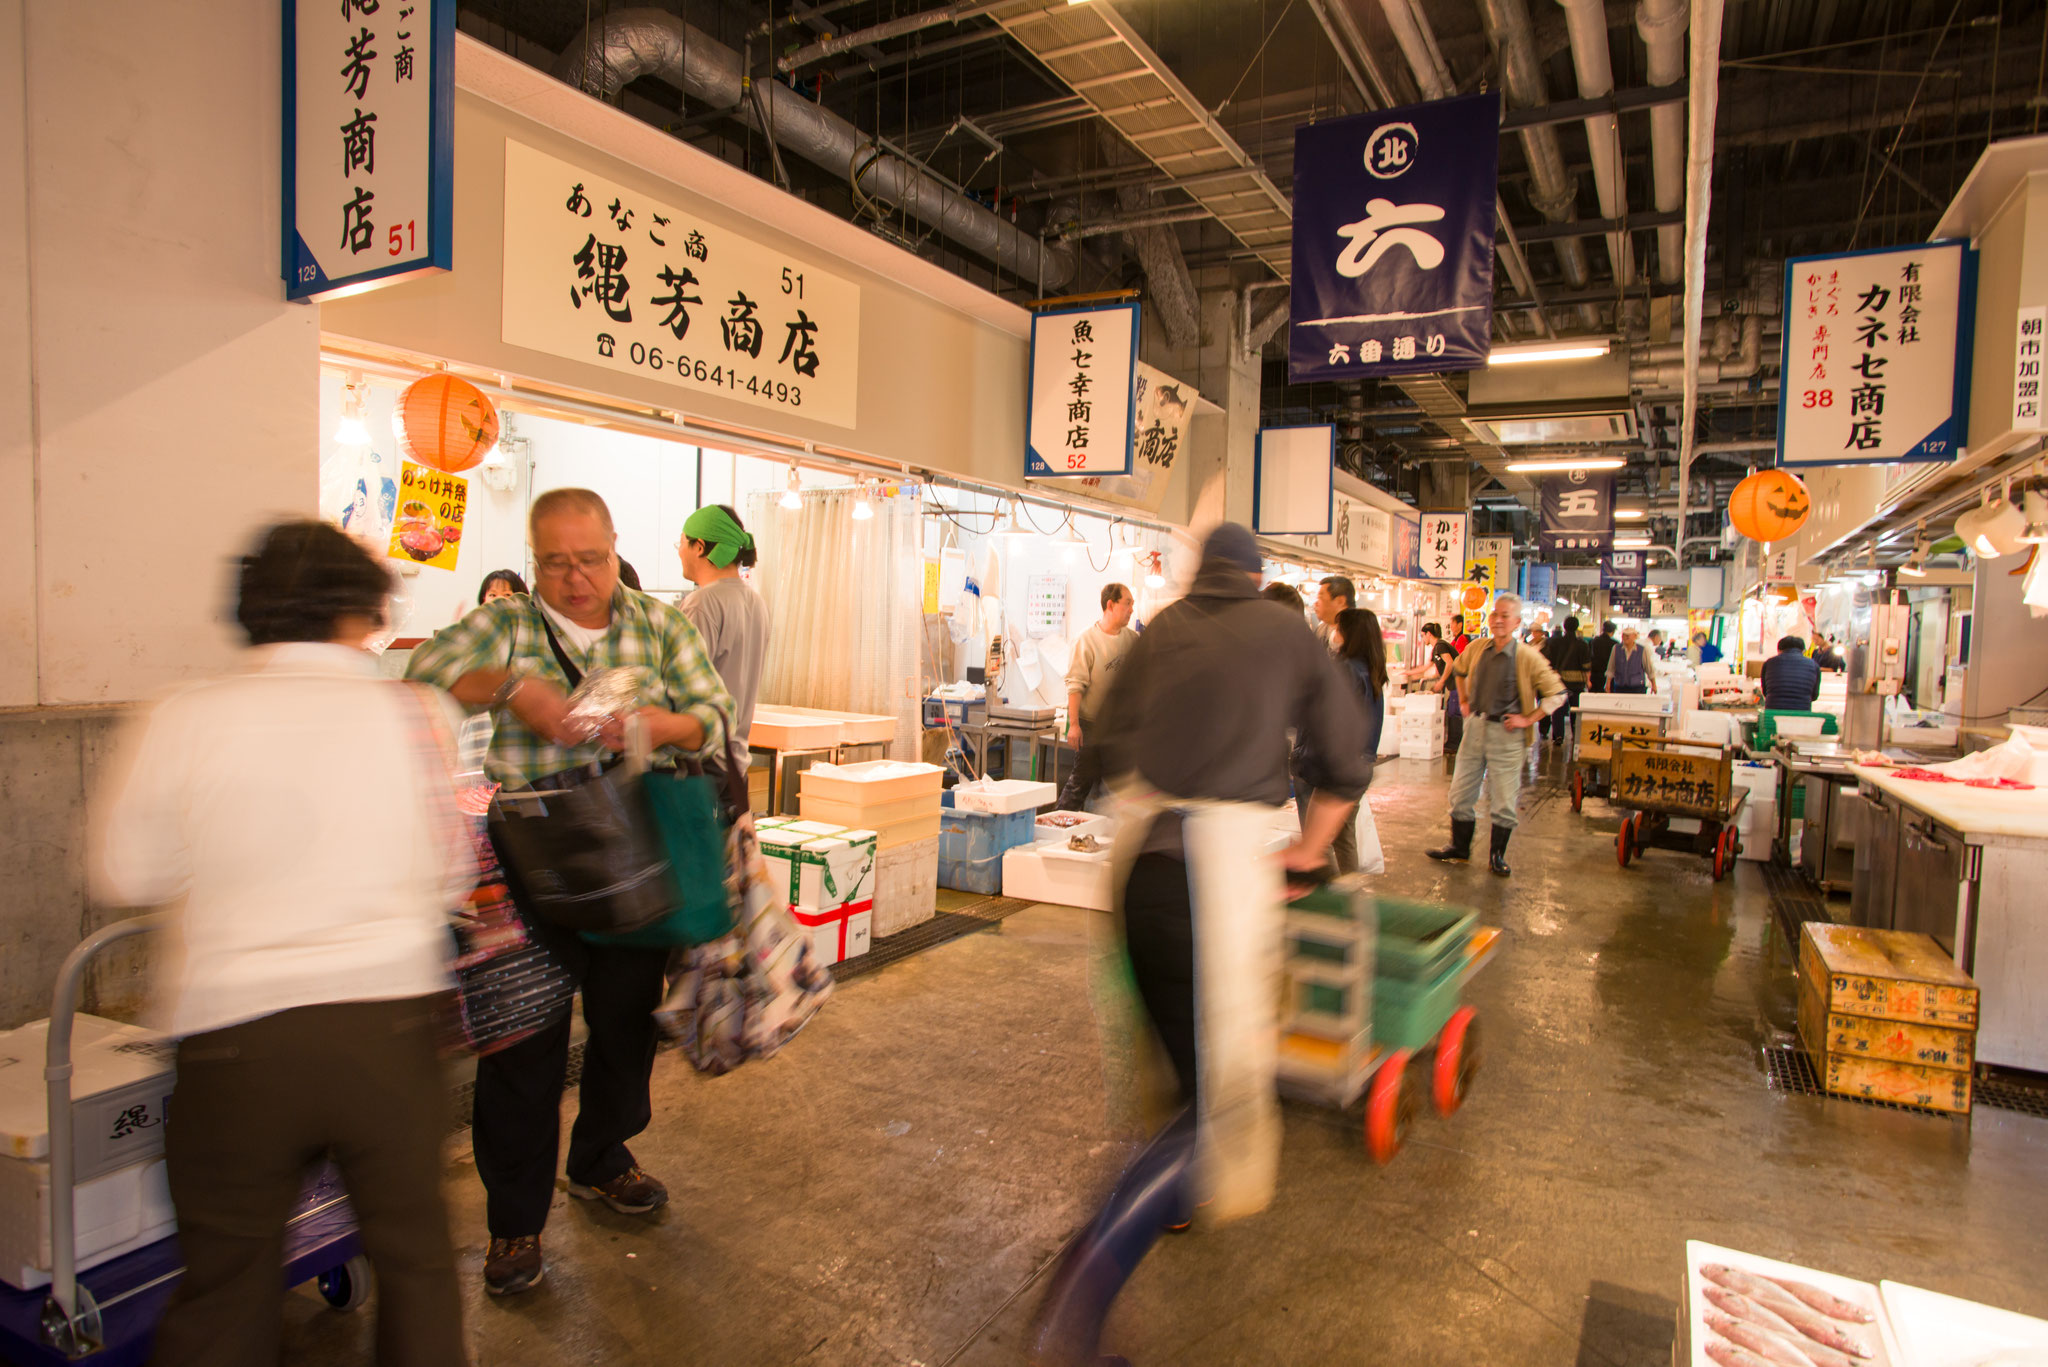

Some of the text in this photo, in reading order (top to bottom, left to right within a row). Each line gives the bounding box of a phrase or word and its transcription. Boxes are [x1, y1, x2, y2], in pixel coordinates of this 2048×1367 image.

[1378, 136, 1408, 168] 北
[388, 219, 415, 256] 51
[565, 182, 710, 264] あなご商
[1336, 198, 1446, 278] 六
[297, 264, 316, 283] 129
[780, 266, 806, 300] 51
[570, 233, 821, 379] 縄芳商店
[1806, 272, 1822, 319] かじき
[1826, 269, 1842, 318] まぐろ
[1897, 261, 1924, 345] 有限会社
[1328, 334, 1447, 366] 六番通り
[1808, 324, 1831, 381] 専門店
[1844, 283, 1891, 451] カネセ商店
[629, 341, 802, 408] 06-6641-4493
[1064, 319, 1095, 450] 魚セ幸商店
[2016, 317, 2043, 419] 朝市加盟店
[1802, 389, 1834, 409] 38
[1067, 453, 1087, 469] 52
[1134, 418, 1179, 469] 商店
[1921, 441, 1947, 454] 127
[1031, 461, 1046, 471] 128
[402, 469, 467, 502] のっけ丼祭
[1557, 489, 1599, 517] 五
[440, 502, 465, 523] の店
[1434, 519, 1451, 570] かね文
[1612, 552, 1637, 569] 四
[1645, 757, 1695, 775] 有限会社
[1625, 772, 1715, 807] カネセ商店
[109, 1104, 161, 1139] 縄
